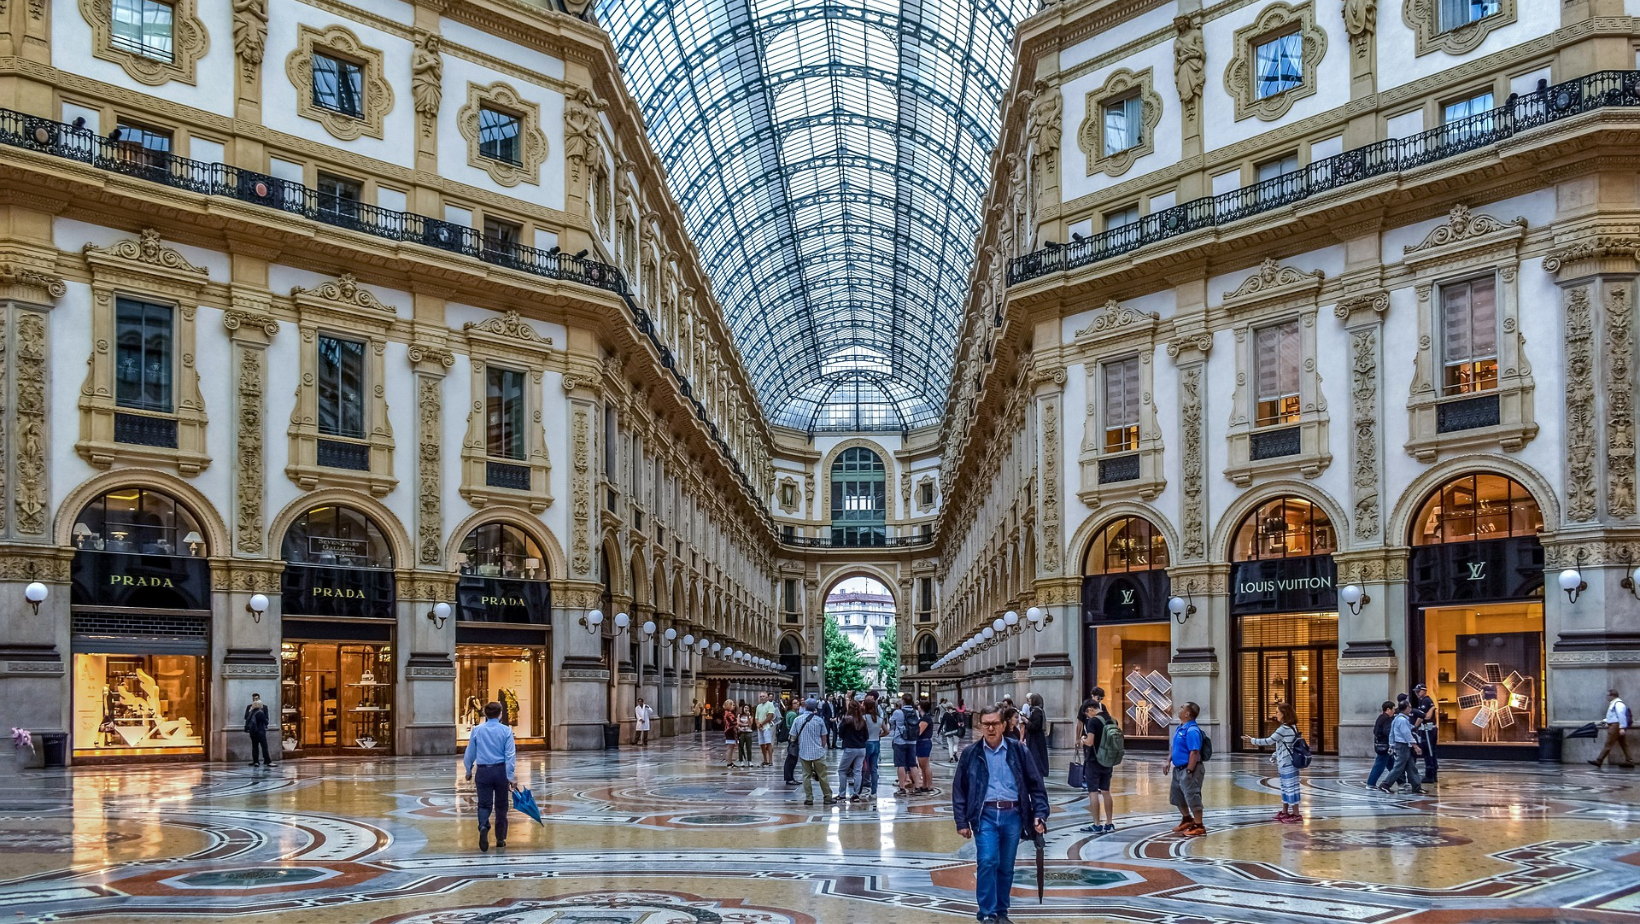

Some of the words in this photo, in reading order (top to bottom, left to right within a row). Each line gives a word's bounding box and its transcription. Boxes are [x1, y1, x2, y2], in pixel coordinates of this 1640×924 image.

[110, 574, 174, 588] PRADA
[1240, 580, 1275, 594] LOUIS
[1277, 576, 1331, 592] VUITTON
[313, 586, 366, 599] PRADA
[481, 595, 525, 607] PRADA
